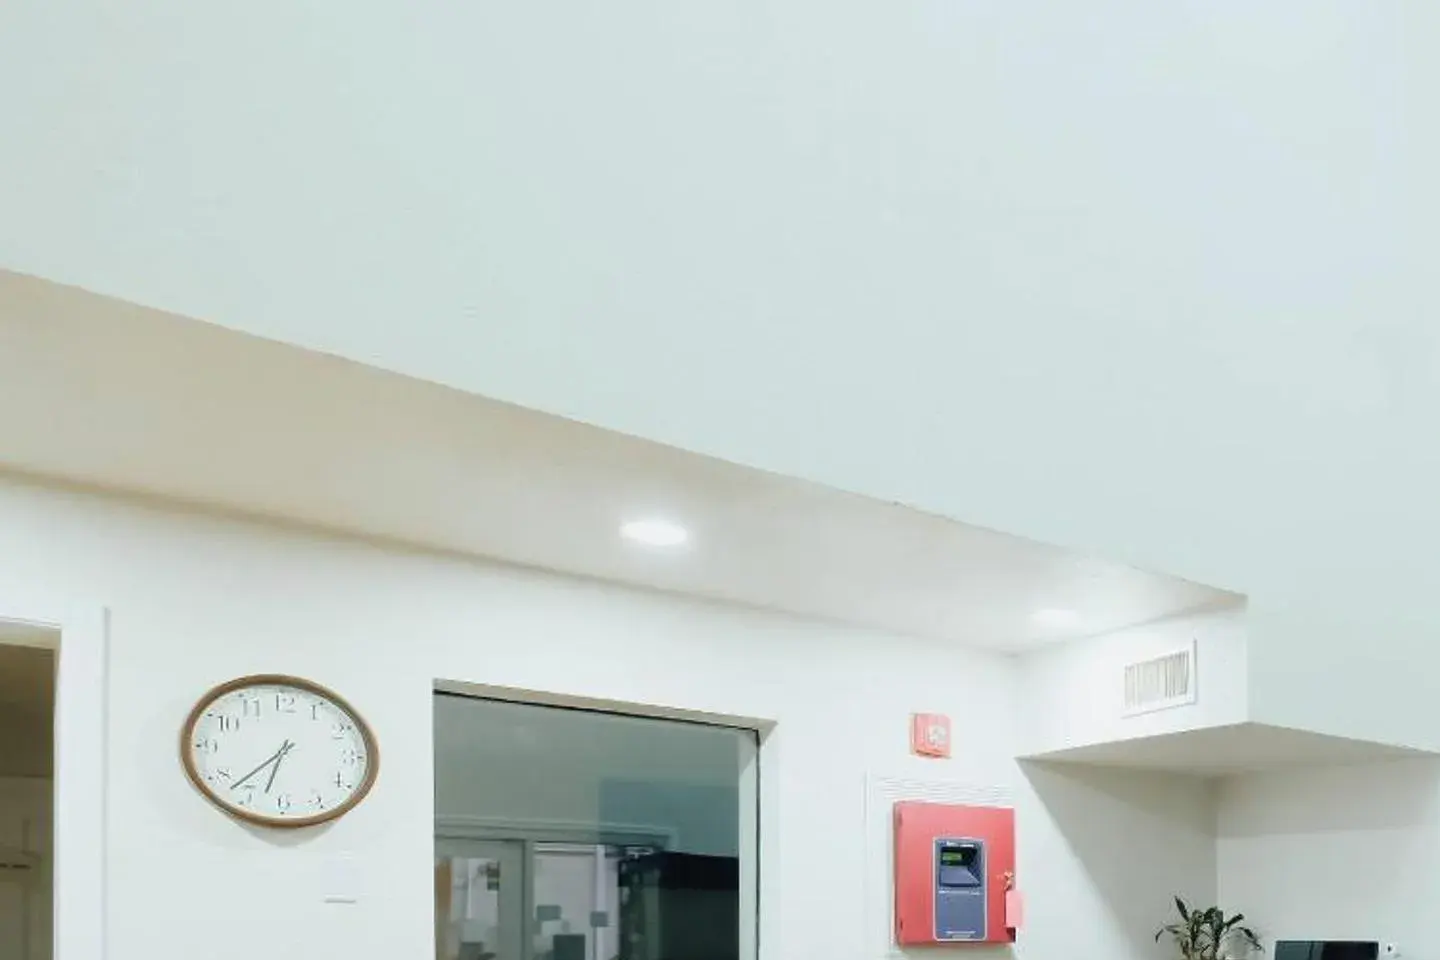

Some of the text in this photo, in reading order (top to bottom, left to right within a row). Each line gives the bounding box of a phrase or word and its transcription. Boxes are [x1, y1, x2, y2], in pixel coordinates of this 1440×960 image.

[242, 698, 261, 716] 11
[275, 692, 297, 713] 12
[217, 715, 240, 732] 10
